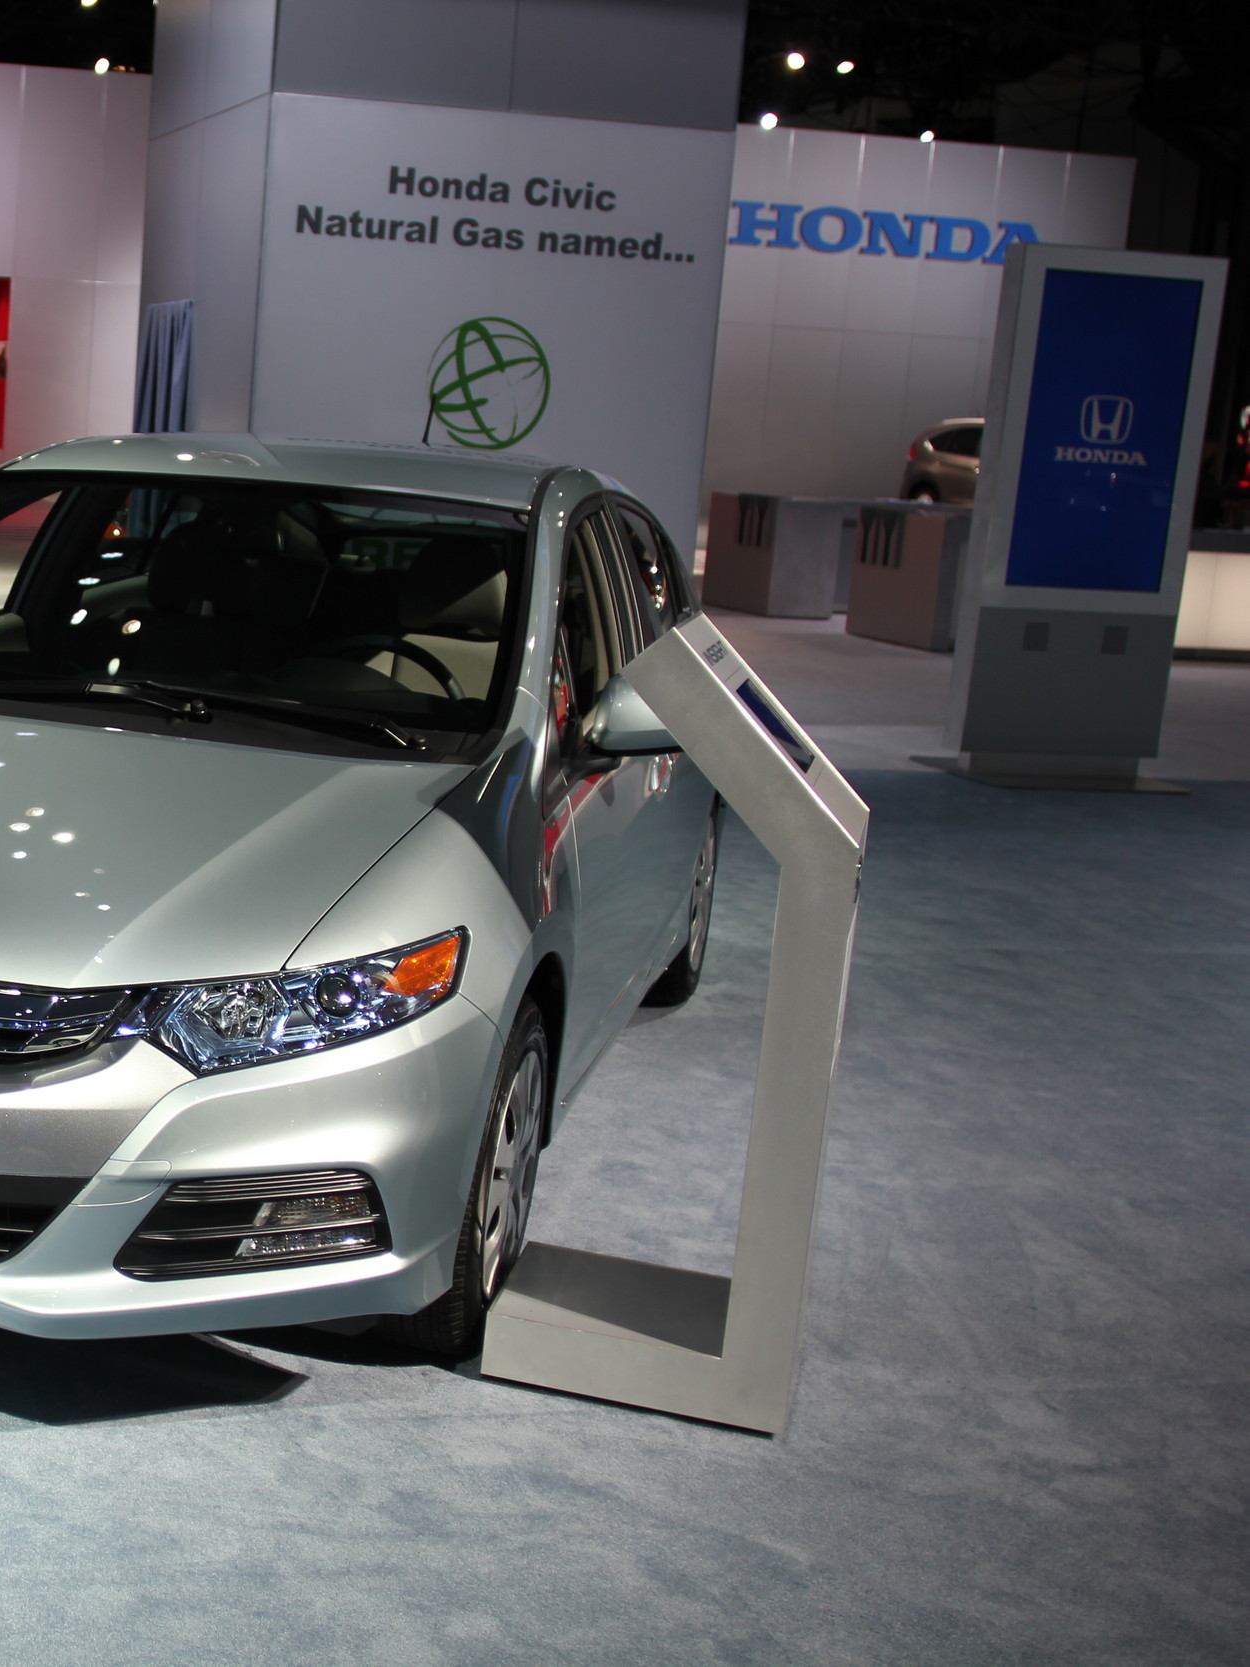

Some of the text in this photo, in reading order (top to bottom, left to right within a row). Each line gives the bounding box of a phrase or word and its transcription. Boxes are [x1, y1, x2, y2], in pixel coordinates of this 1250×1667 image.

[388, 165, 617, 212] Honda Civic
[296, 204, 695, 263] Natural Gas named...
[728, 200, 1039, 264] HONDA
[1054, 446, 1147, 466] HONDA
